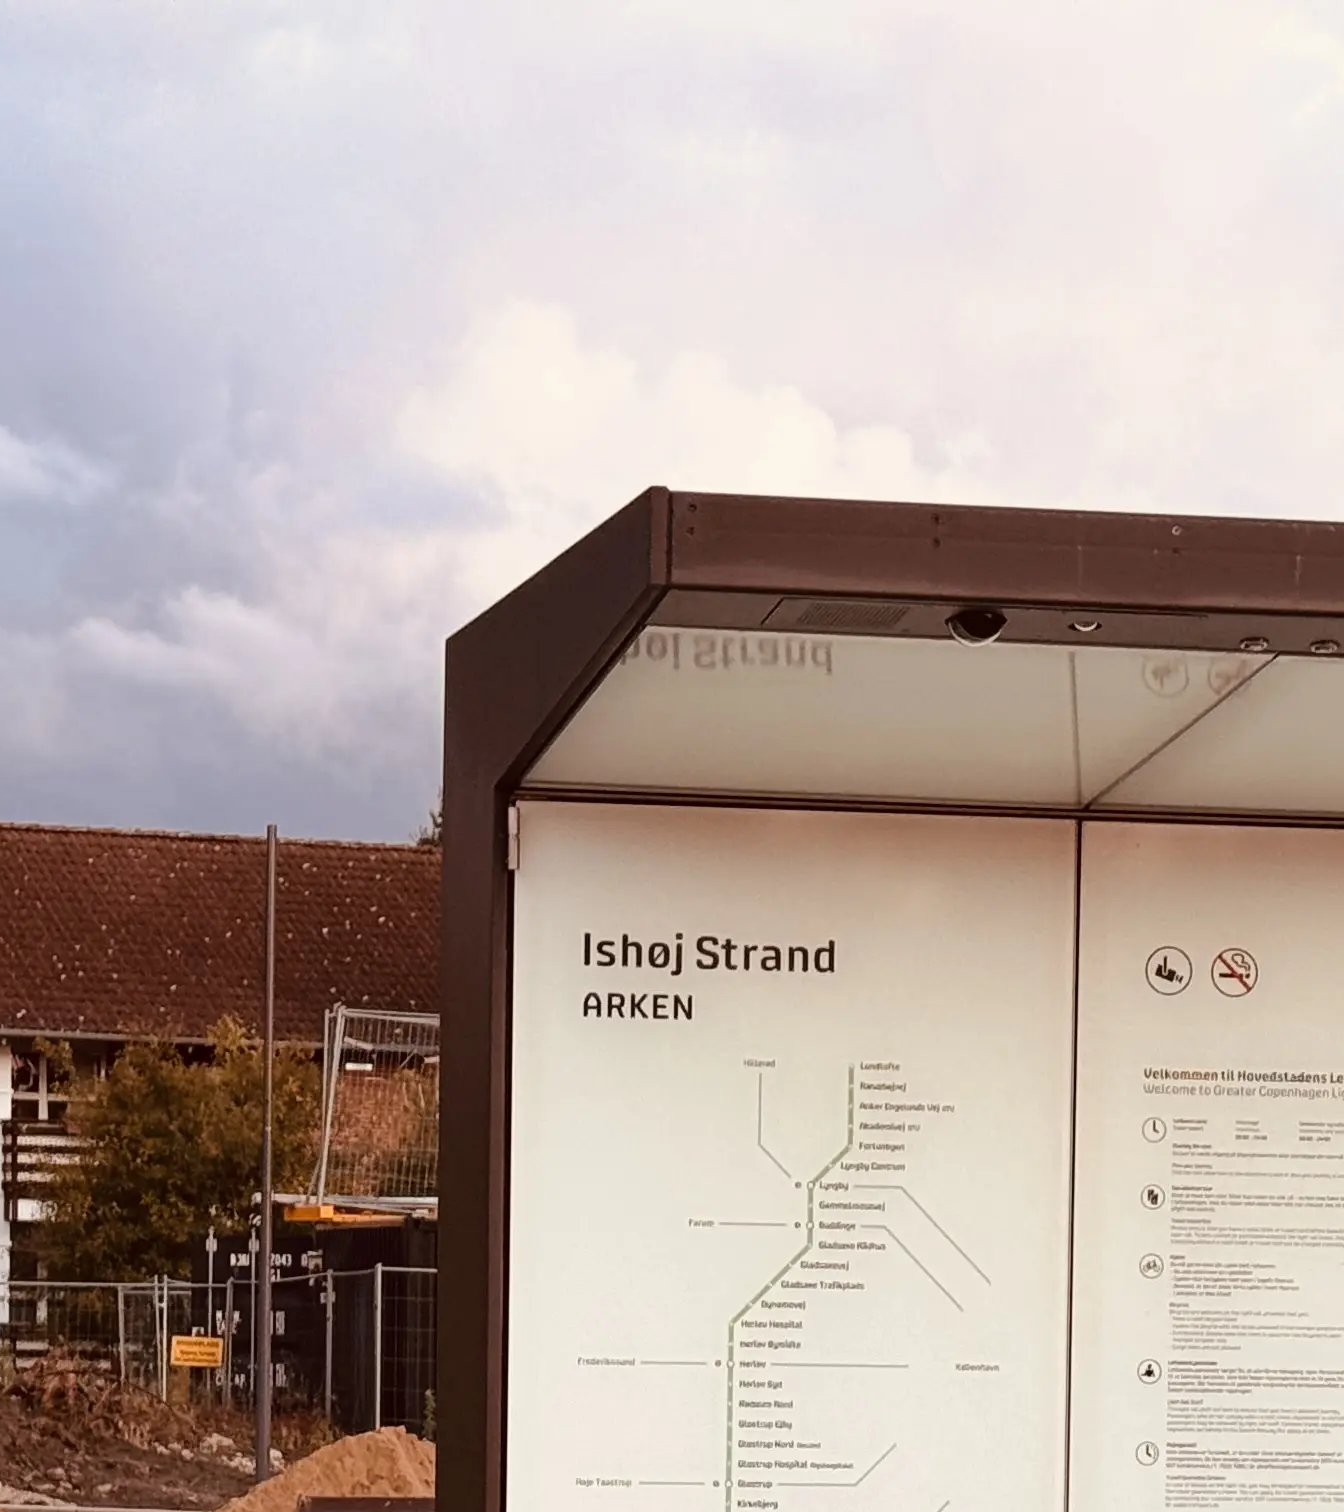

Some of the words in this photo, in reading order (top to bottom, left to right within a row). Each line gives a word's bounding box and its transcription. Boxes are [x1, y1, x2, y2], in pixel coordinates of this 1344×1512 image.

[584, 933, 683, 976] Ishøj
[696, 936, 835, 973] Strand
[584, 993, 692, 1020] ARKEN
[1144, 1068, 1218, 1081] Velkommen
[1221, 1070, 1234, 1081] til
[1238, 1070, 1327, 1084] Hovedstadens
[1143, 1084, 1196, 1095] Welcome
[1199, 1085, 1211, 1096] to
[1214, 1085, 1256, 1096] Greater
[1259, 1086, 1329, 1100] Copenhagen
